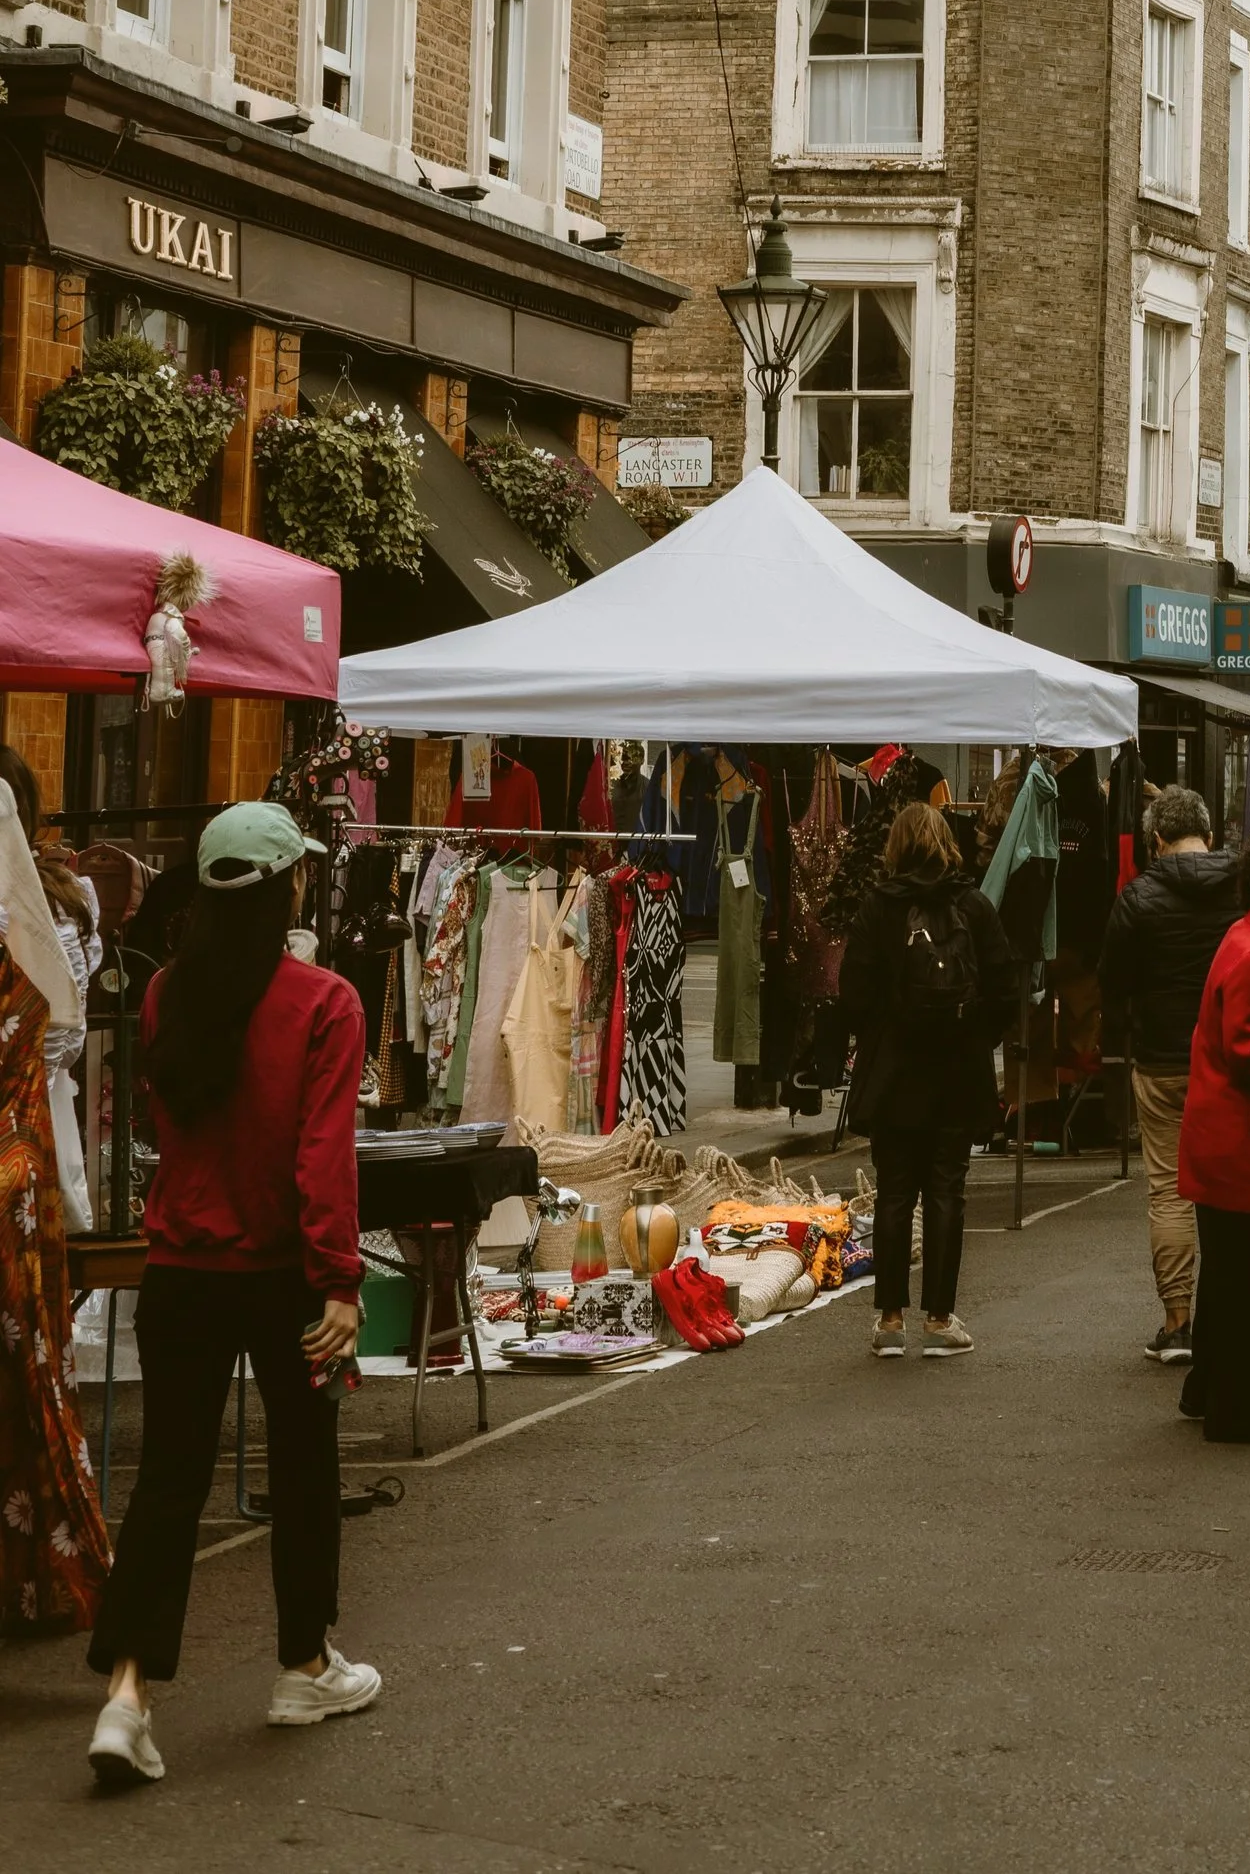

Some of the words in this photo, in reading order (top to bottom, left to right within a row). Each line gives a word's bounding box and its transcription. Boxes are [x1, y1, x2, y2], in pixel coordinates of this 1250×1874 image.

[566, 146, 599, 175] ORTOBELLO
[127, 196, 234, 281] UKAI
[625, 459, 703, 471] LANCASTER
[1158, 602, 1208, 647] GREGGS
